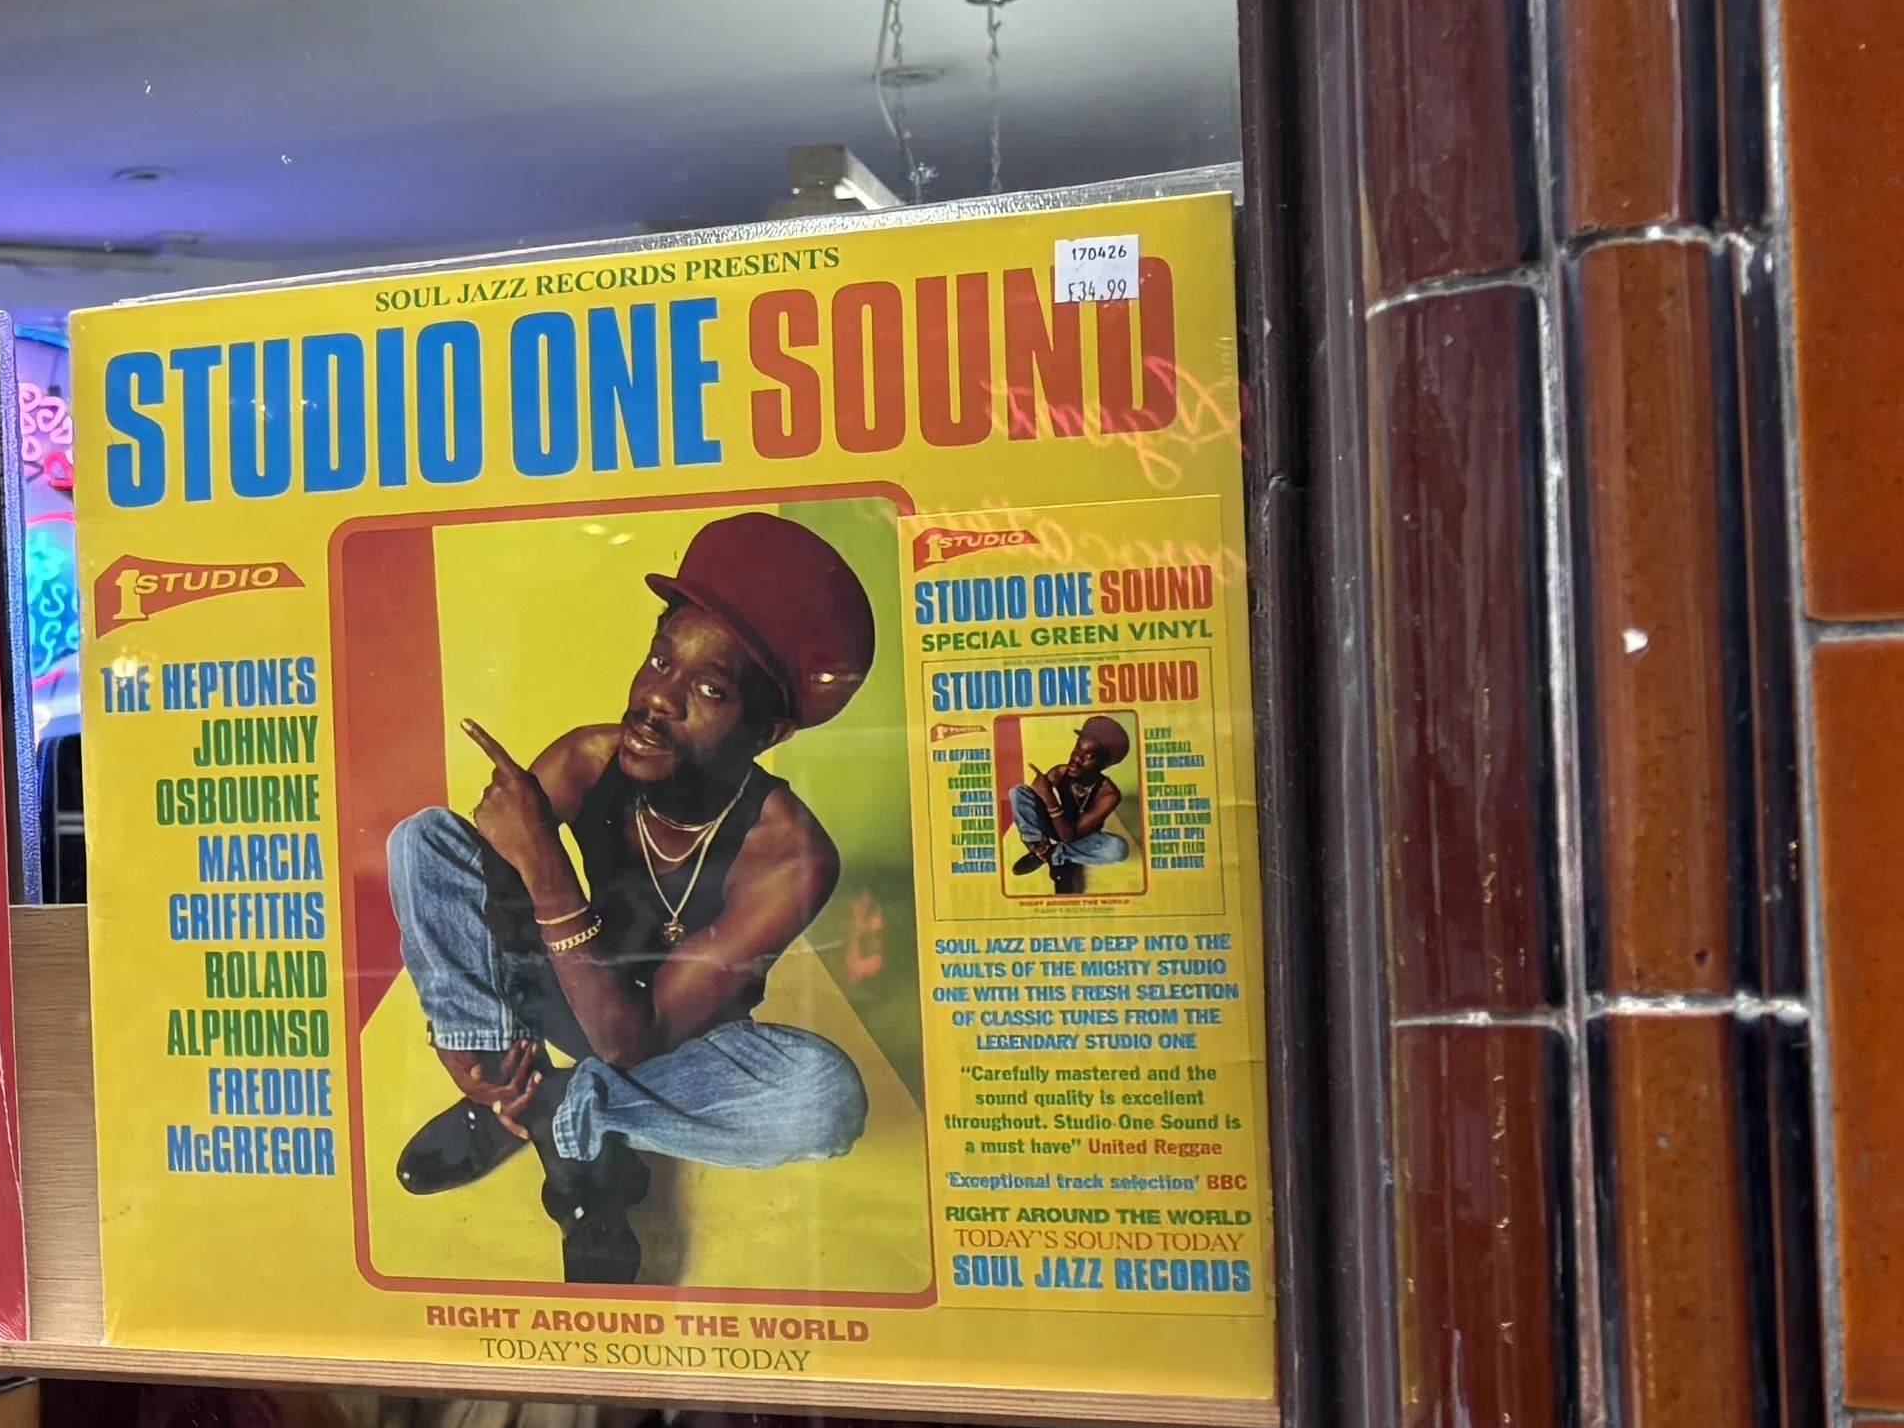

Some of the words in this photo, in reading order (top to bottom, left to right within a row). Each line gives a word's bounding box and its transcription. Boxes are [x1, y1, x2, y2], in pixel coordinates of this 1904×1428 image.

[1072, 244, 1128, 261] 170426
[375, 285, 451, 314] SOUL
[457, 277, 529, 306] JAZZ
[535, 264, 678, 298] RECORDS
[684, 247, 841, 282] PRESENTS
[103, 319, 482, 508] STUDIO
[510, 297, 722, 479] ONE
[748, 256, 1178, 461] SOUND
[135, 566, 280, 595] STUDIO
[914, 574, 1026, 625] STUDIO
[1033, 571, 1095, 618] ONE
[1100, 564, 1213, 615] SOUND
[921, 627, 1021, 653] SPECIAL
[1030, 623, 1119, 647] GREEN
[1127, 618, 1213, 641] VINYL
[99, 664, 151, 714] THE
[161, 656, 317, 711] HEPTONES
[931, 666, 1033, 712] STUDIO
[1038, 664, 1092, 707] ONE
[1097, 659, 1199, 704] SOUND
[193, 715, 319, 767] JOHNNY
[155, 773, 321, 826] OSBOURNE
[198, 832, 324, 883] MARCIA
[168, 891, 326, 941] GRIFFITHS
[204, 950, 328, 1000] ROLAND
[166, 1008, 330, 1058] ALPHONSO
[208, 1067, 333, 1117] FREDDIE
[1055, 1064, 1140, 1081] mastered
[1147, 1064, 1181, 1081] and
[1186, 1064, 1217, 1081] the
[975, 1089, 1027, 1106] sound
[1034, 1088, 1094, 1108] quality
[1099, 1088, 1116, 1106] is
[1121, 1088, 1205, 1105] excellent
[944, 1113, 1048, 1132] throughout.
[1160, 1113, 1218, 1130] Sound
[1224, 1113, 1242, 1130] is
[166, 1124, 336, 1176] McGREGOR
[964, 1141, 975, 1154] a
[980, 1139, 1025, 1154] must
[1088, 1138, 1148, 1155] United
[1154, 1139, 1223, 1158] Reggae
[1056, 1174, 1104, 1190] track
[1206, 1174, 1248, 1191] BBC
[945, 1206, 1010, 1223] RIGHT
[1015, 1207, 1110, 1224] AROUND
[1116, 1208, 1162, 1225] THE
[1166, 1209, 1252, 1226] WORLD
[1064, 1230, 1152, 1251] SOUND
[1153, 1232, 1245, 1252] TODAY
[952, 1254, 1024, 1288] SOUL
[1034, 1256, 1104, 1290] JAZZ
[1114, 1257, 1252, 1294] RECORDS
[426, 1304, 521, 1329] RIGHT
[531, 1309, 665, 1336] AROUND
[674, 1313, 740, 1338] THE
[749, 1317, 869, 1343] WORLD
[606, 1343, 706, 1368] SOUND
[706, 1346, 811, 1372] TODAY
